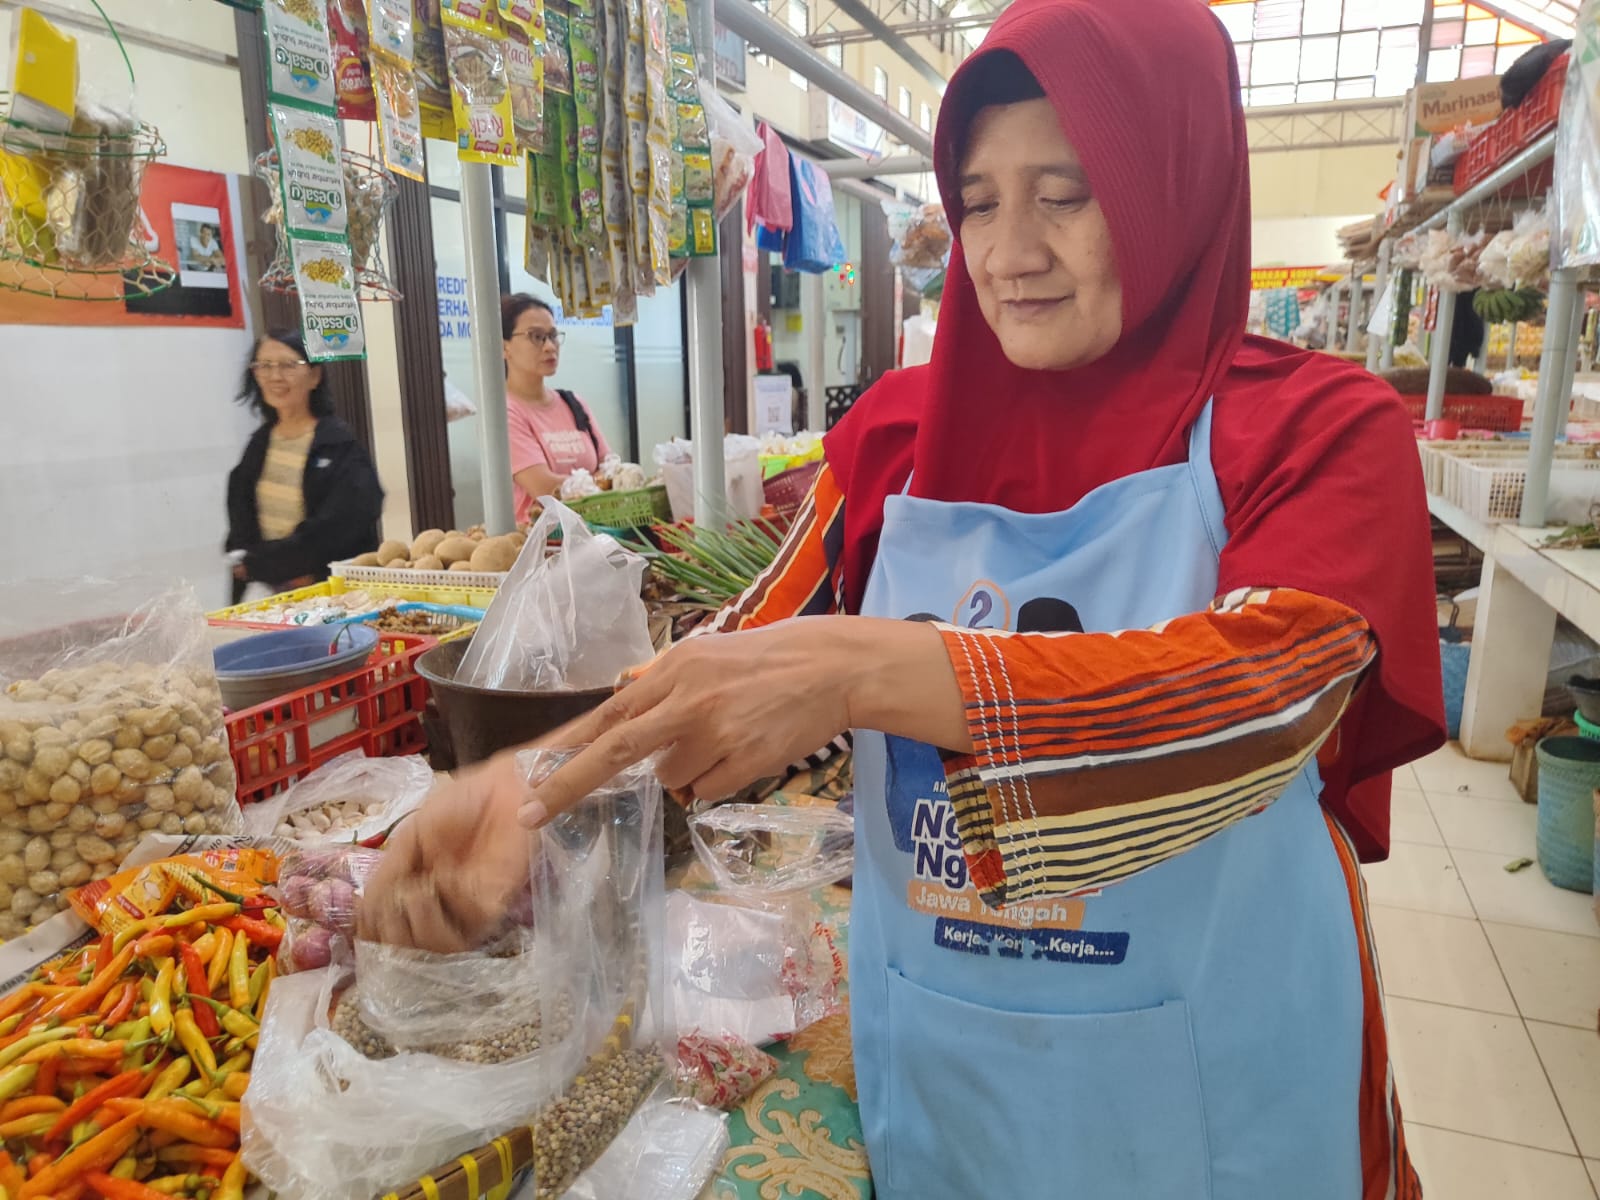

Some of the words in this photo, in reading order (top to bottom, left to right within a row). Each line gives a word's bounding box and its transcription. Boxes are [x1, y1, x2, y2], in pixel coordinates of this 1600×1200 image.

[276, 45, 329, 81] Desaku
[290, 181, 341, 210] Desaku
[438, 276, 467, 295] REDI
[305, 312, 358, 335] Desaku
[968, 590, 993, 629] 2
[915, 886, 970, 912] Jawa
